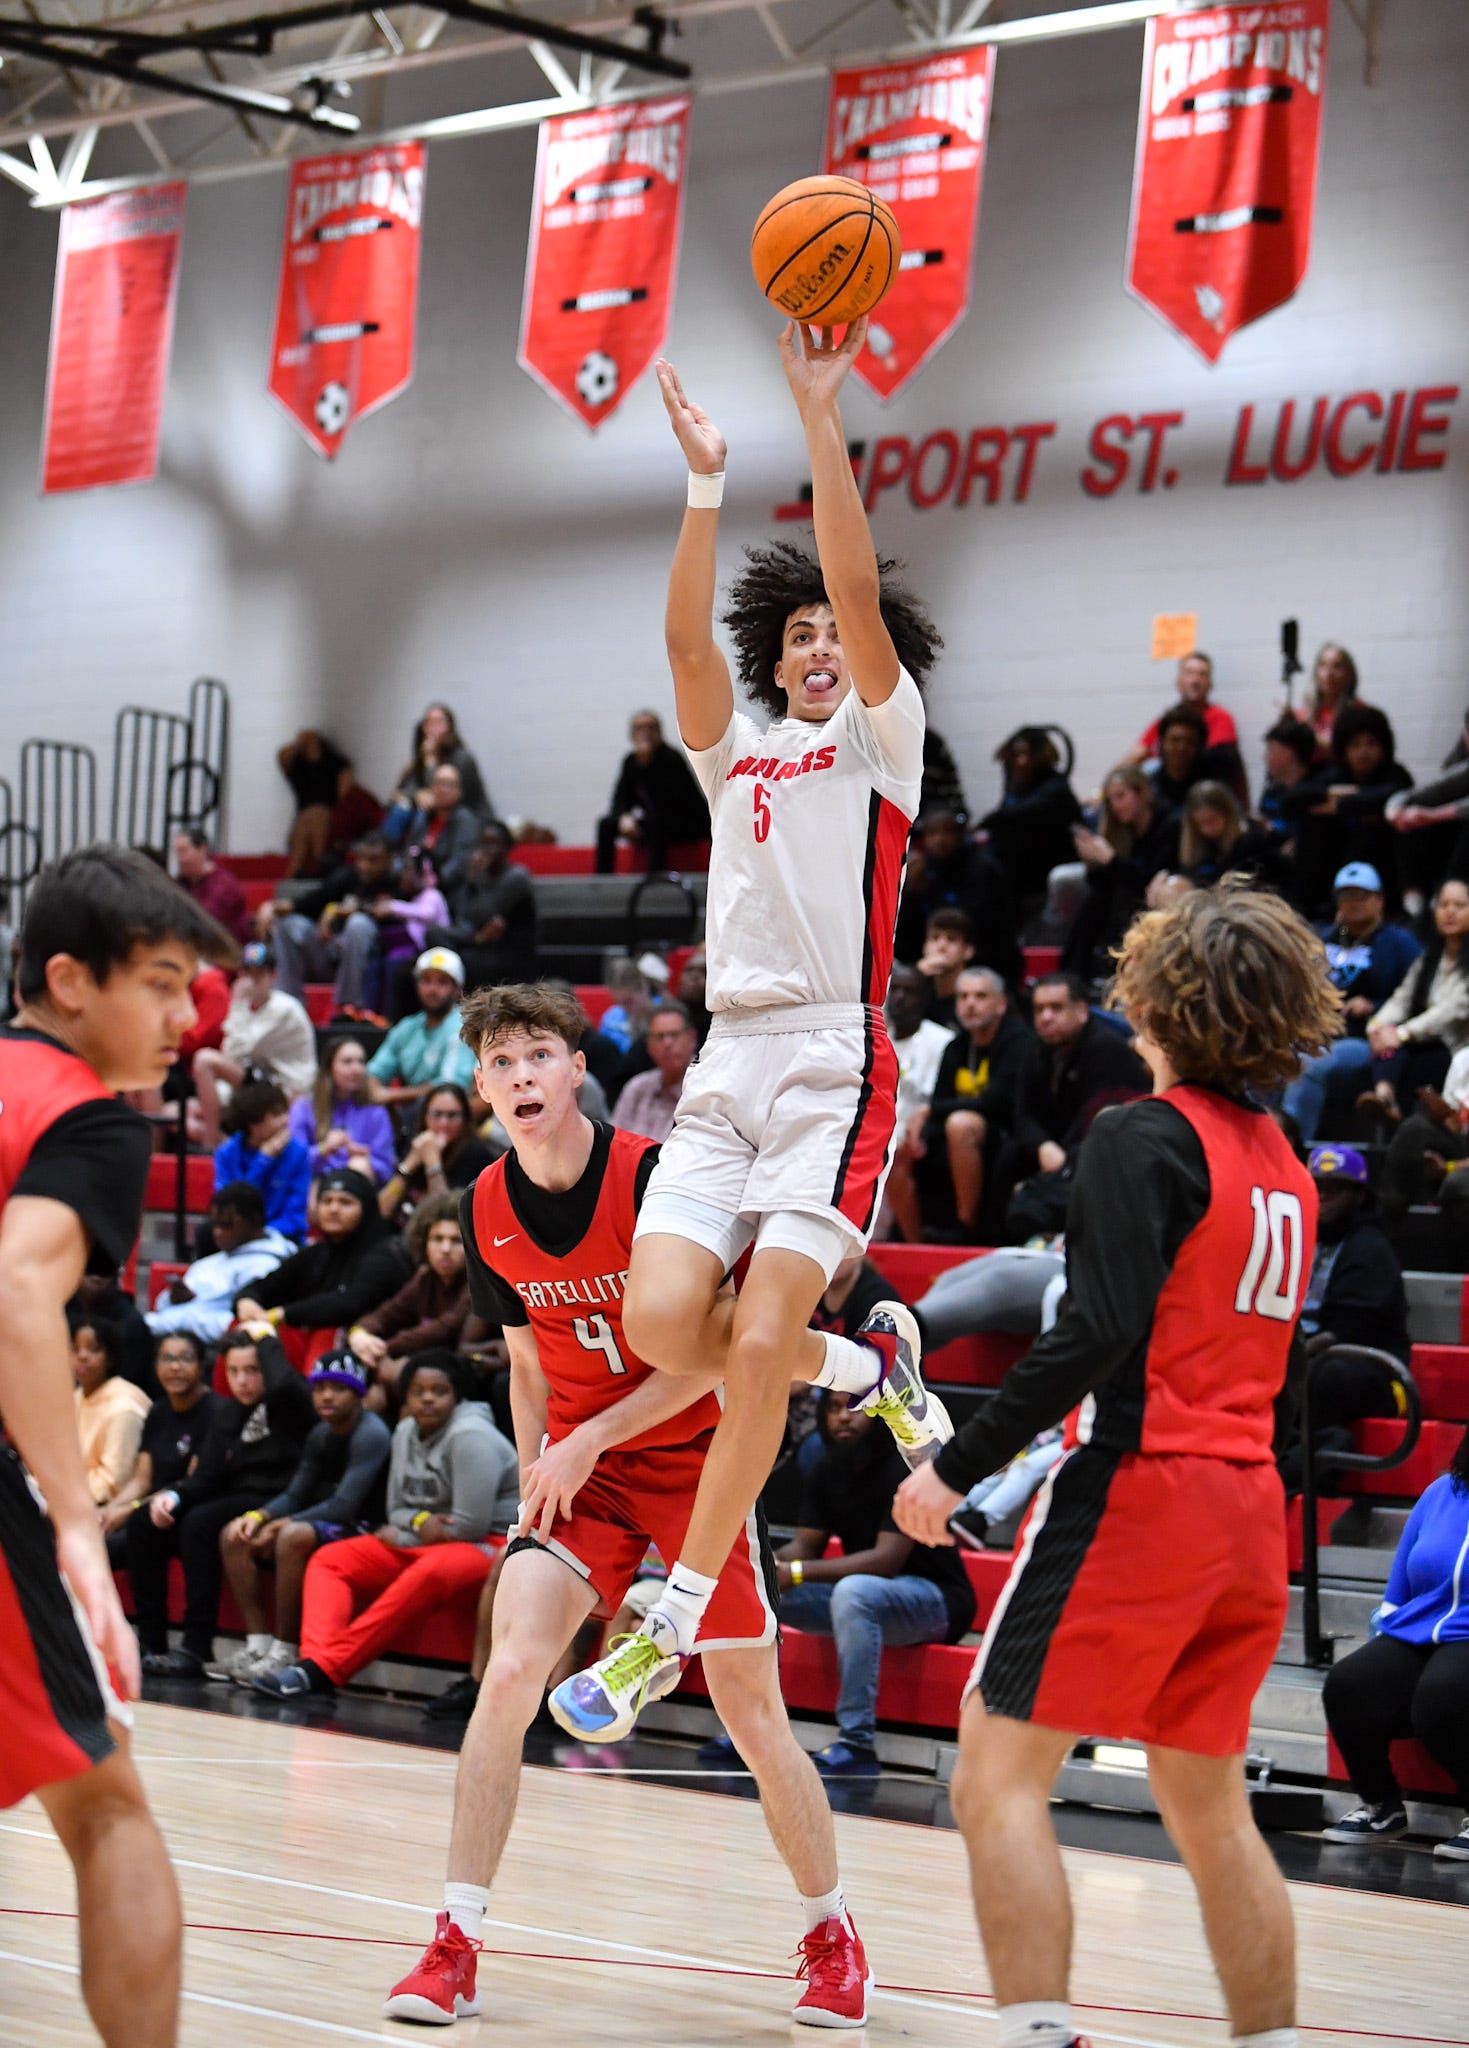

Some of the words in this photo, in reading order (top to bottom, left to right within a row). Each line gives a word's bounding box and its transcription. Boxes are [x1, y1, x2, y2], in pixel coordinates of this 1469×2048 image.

[1152, 27, 1322, 116] CHAMPIONS
[831, 74, 985, 162] CHAMPIONS
[775, 244, 850, 312] Wilson
[864, 421, 1057, 515] PORT
[1080, 409, 1184, 498] ST.
[1225, 384, 1460, 487] LUCIE
[753, 782, 772, 844] 5
[1234, 1185, 1303, 1323] 10
[571, 1312, 628, 1376] 4
